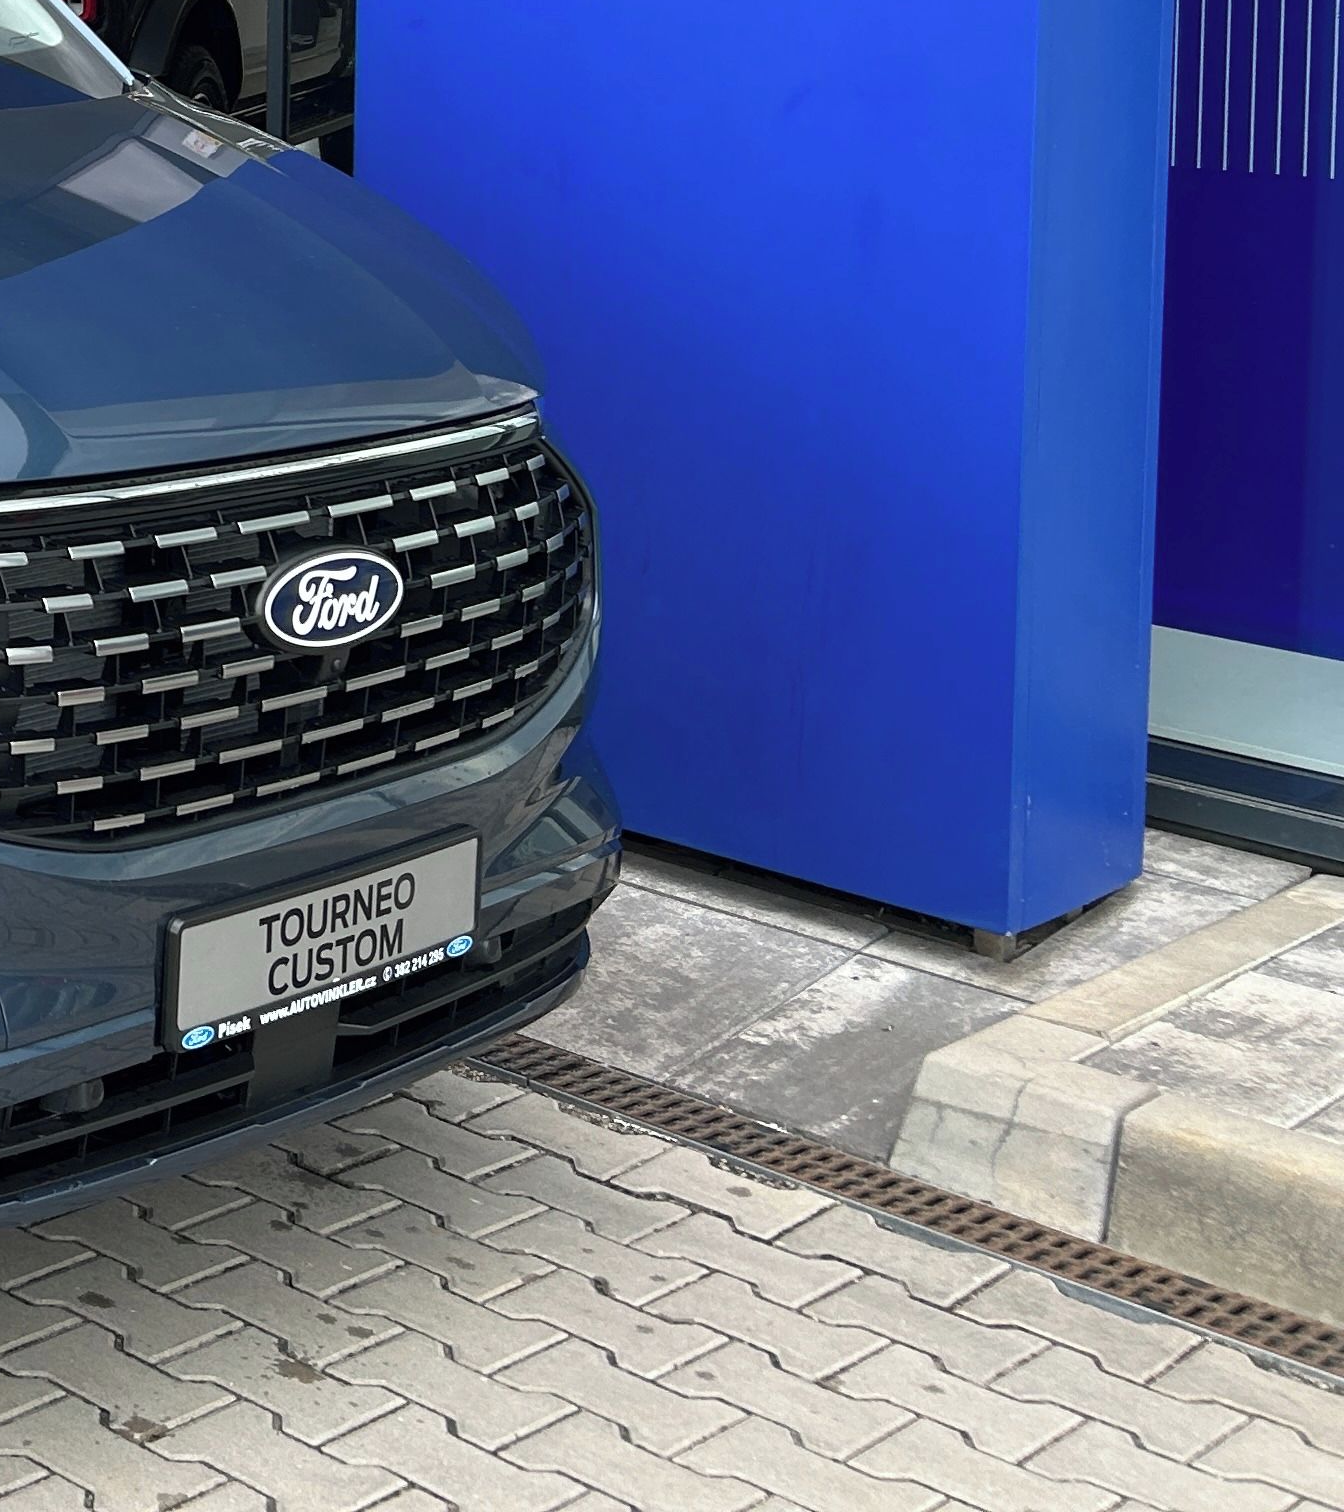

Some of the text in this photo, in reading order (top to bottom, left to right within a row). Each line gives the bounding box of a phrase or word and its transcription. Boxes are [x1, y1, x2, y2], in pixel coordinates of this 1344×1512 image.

[292, 565, 380, 636] Ford
[259, 872, 416, 954] TOURNEO
[268, 918, 404, 996] CUSTOM
[411, 954, 428, 972] 214
